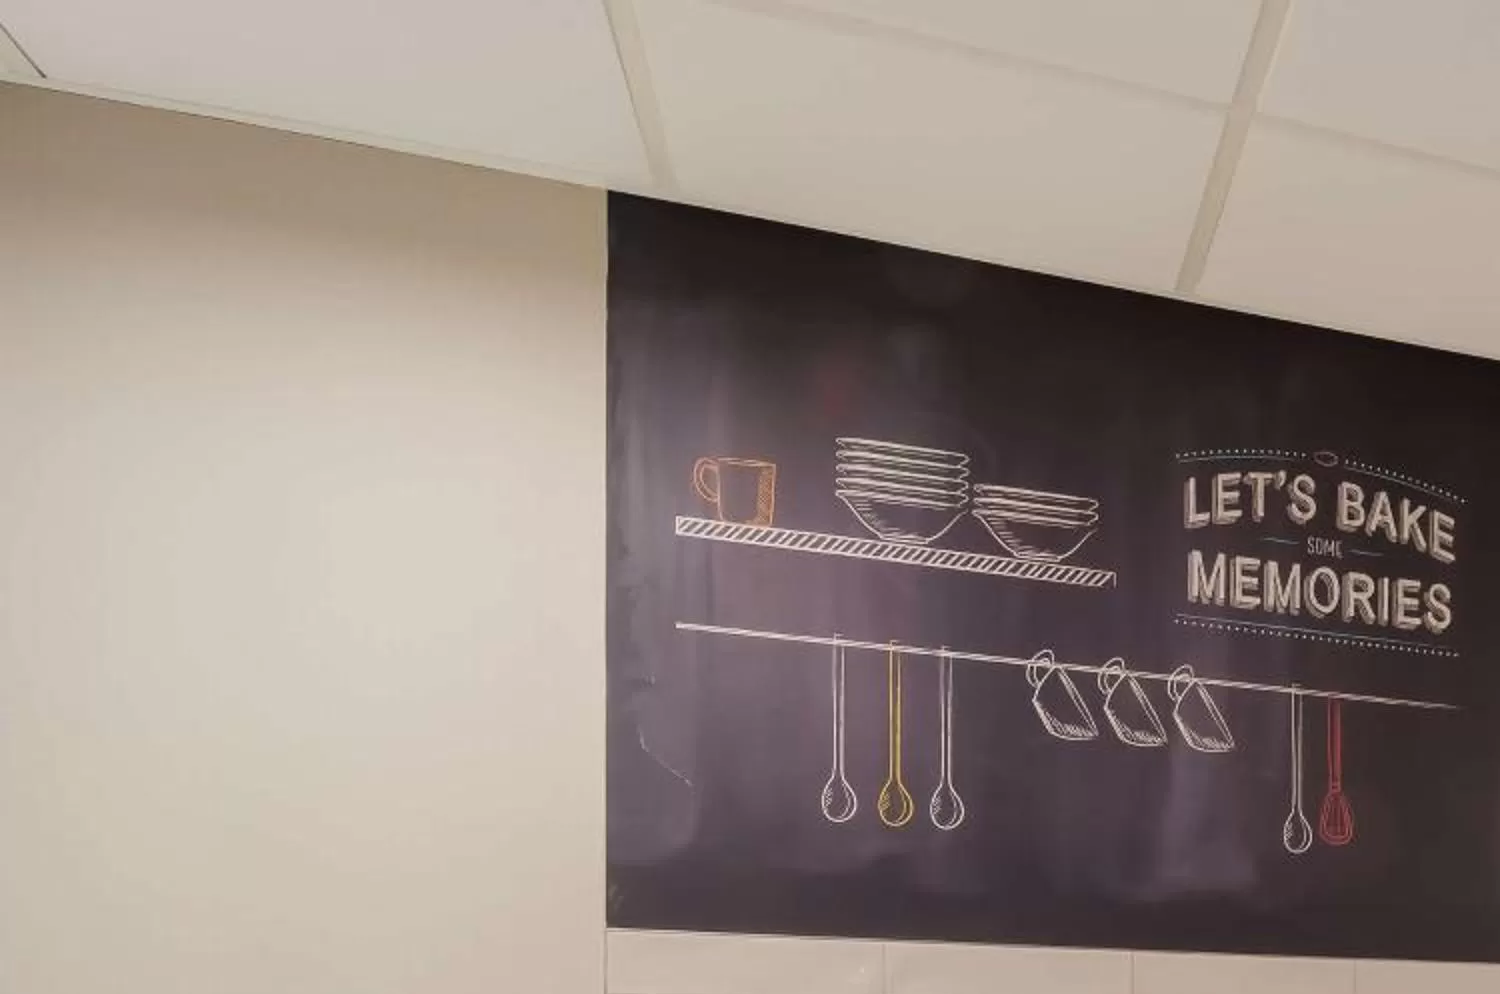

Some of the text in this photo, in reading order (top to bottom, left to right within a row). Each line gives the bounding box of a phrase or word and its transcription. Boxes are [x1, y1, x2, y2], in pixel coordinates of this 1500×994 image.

[1183, 470, 1456, 564] LET'S BAKE
[1307, 536, 1344, 560] SOME
[1187, 548, 1453, 635] MEMORIES
